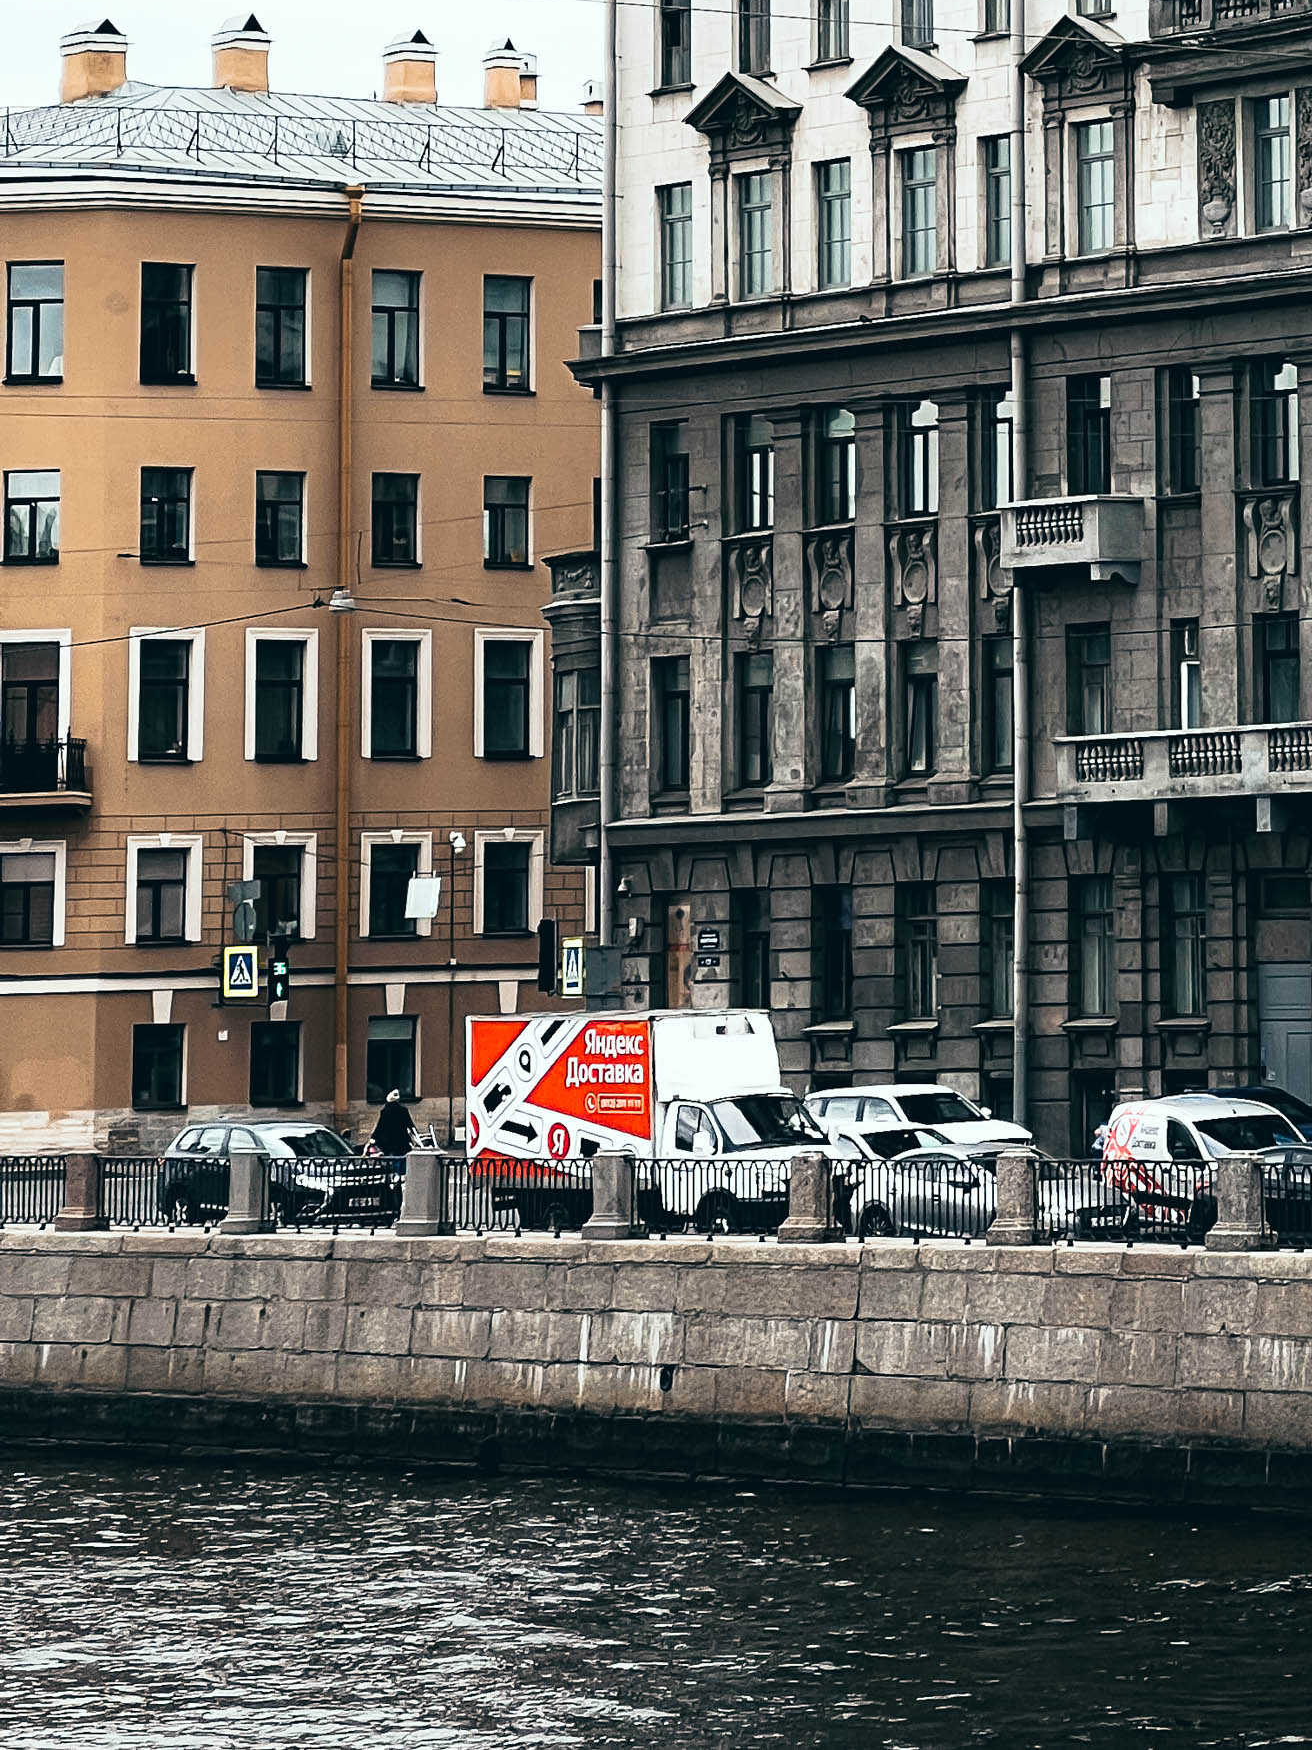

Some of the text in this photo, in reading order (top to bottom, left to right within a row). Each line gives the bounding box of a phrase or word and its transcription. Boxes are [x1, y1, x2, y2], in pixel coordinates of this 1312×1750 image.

[585, 1028, 644, 1058] Яндекс
[565, 1057, 644, 1088] Доставка
[552, 1129, 565, 1156] Я
